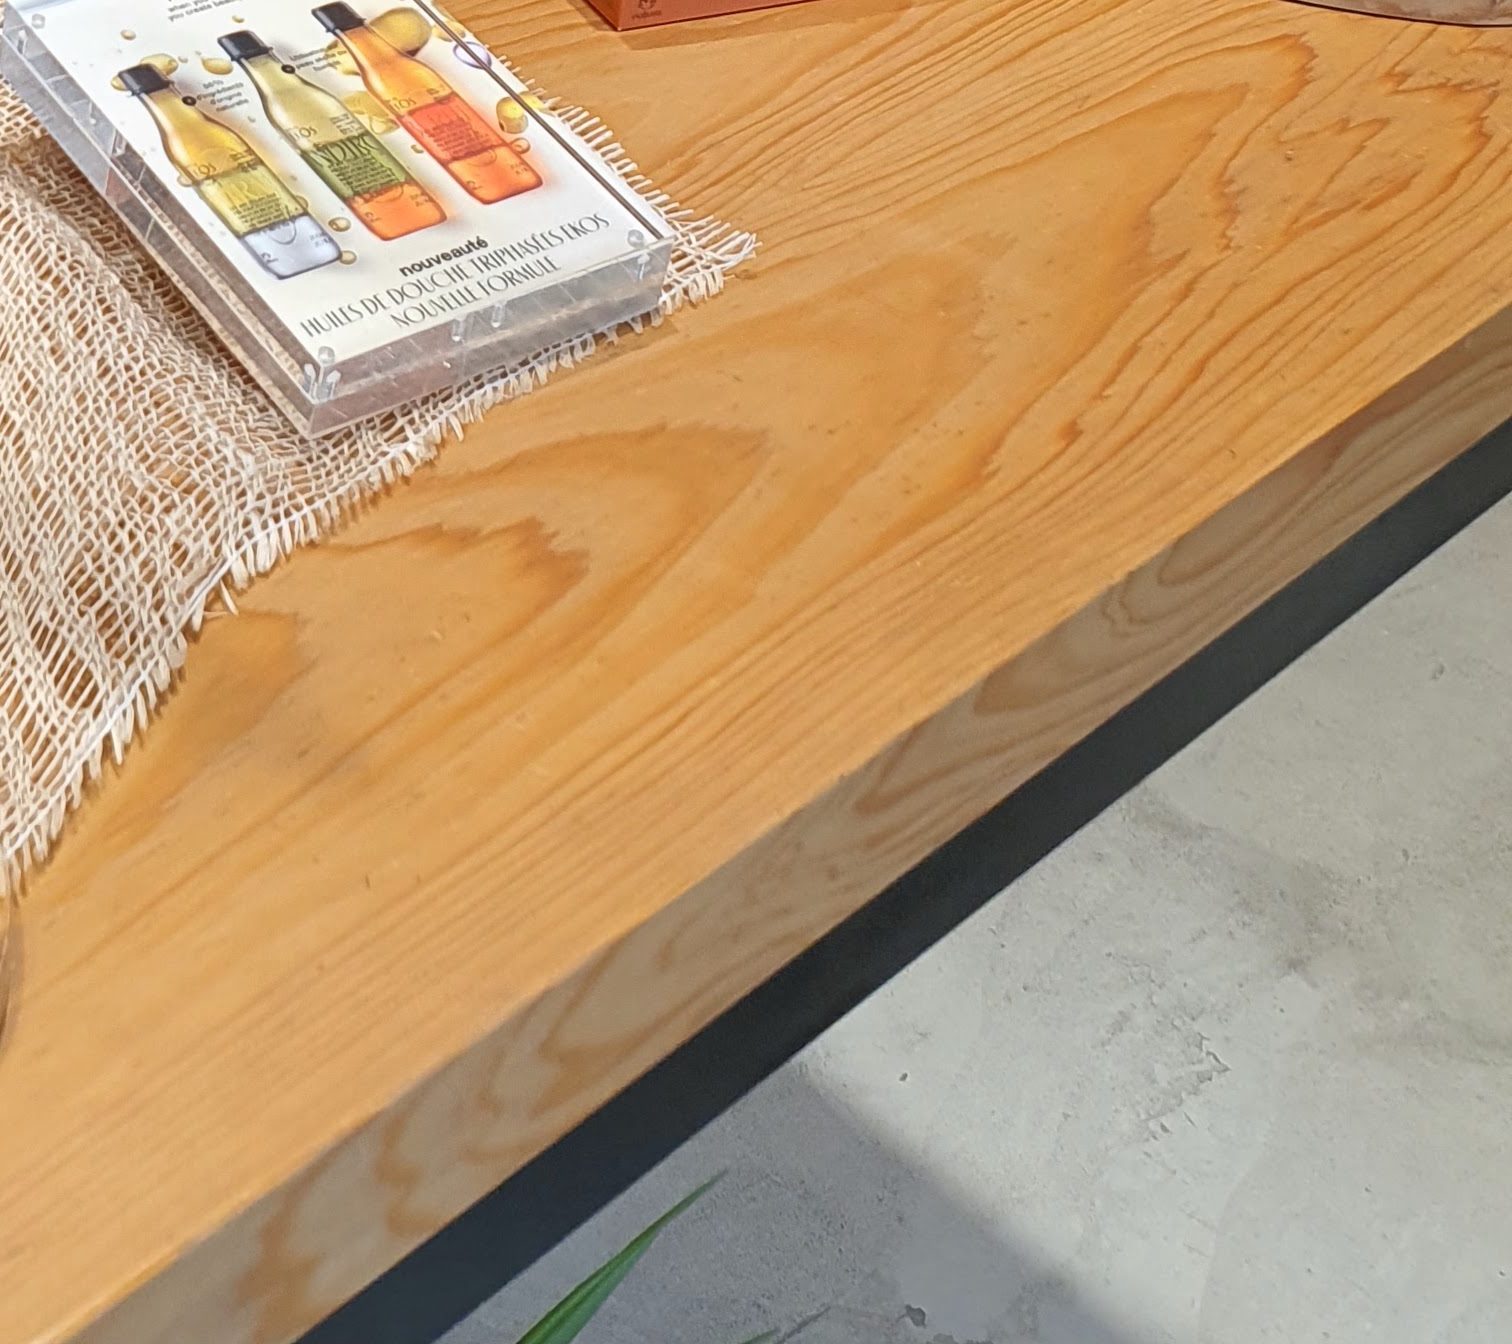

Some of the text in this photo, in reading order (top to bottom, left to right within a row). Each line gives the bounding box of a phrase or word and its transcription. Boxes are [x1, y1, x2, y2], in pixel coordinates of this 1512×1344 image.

[300, 213, 611, 338] HUILES DE DOUCHE TRIPHASÉES EKOS
[390, 254, 561, 329] NOUVELLE FORMULE
[399, 235, 489, 278] nouveauté
